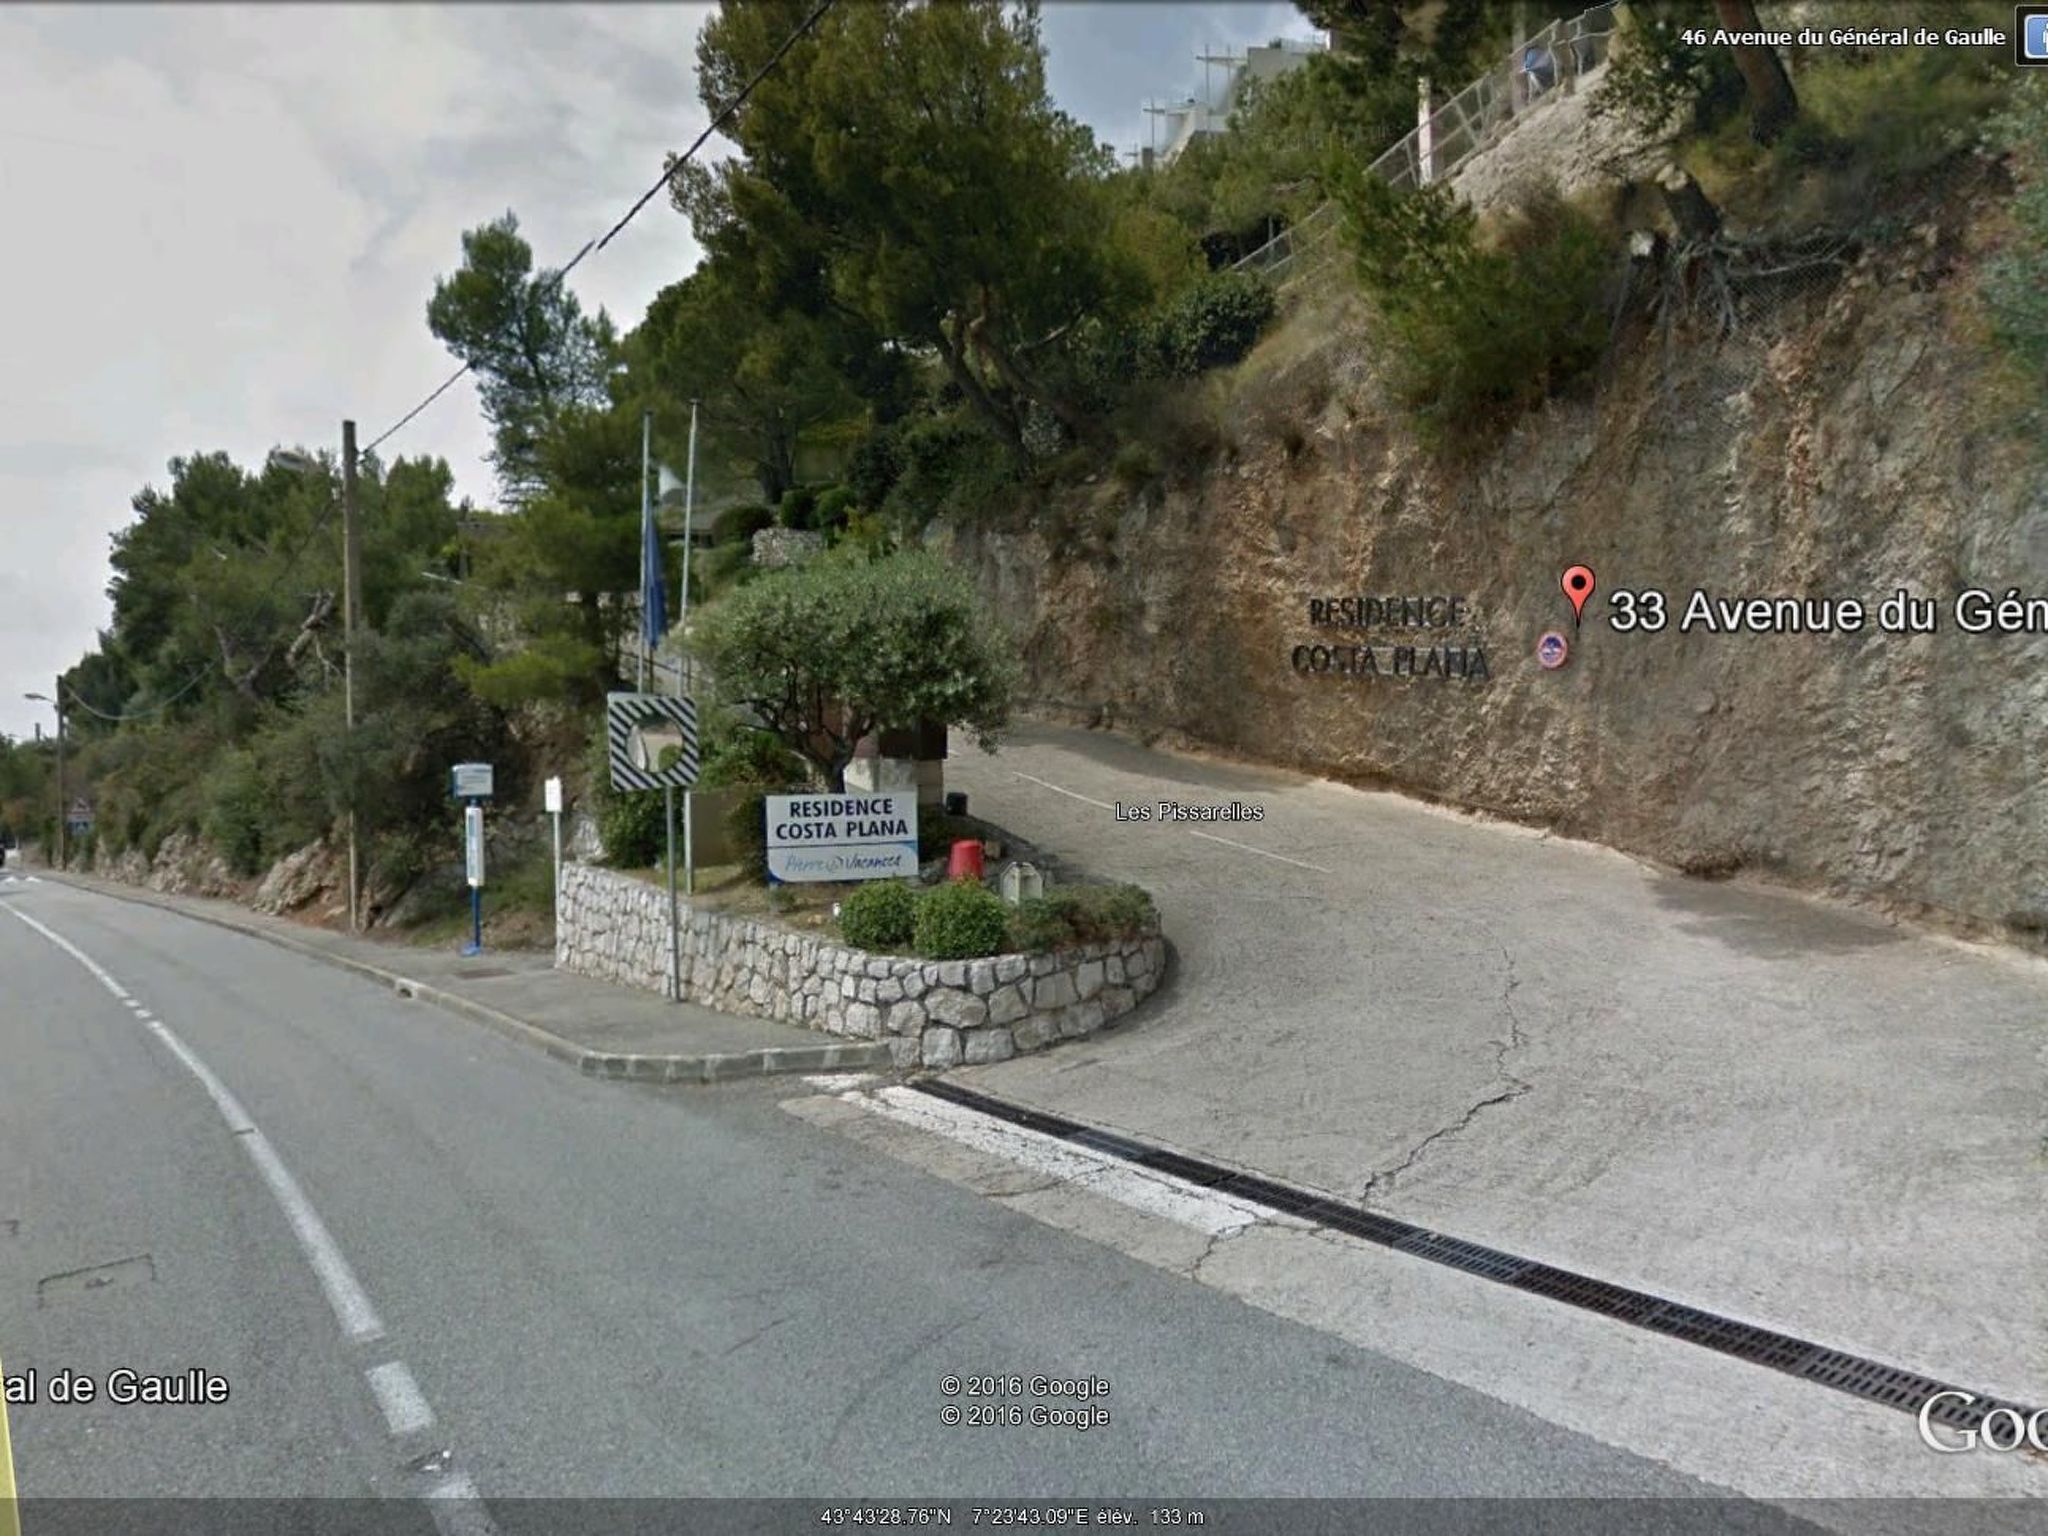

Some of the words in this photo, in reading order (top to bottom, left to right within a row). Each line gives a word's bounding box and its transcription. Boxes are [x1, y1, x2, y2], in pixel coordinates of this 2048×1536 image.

[1310, 597, 1467, 627] RESIDENCE
[1291, 644, 1379, 676] COSTA
[1393, 646, 1490, 680] PLANA
[790, 799, 893, 817] RESIDENCE
[776, 822, 837, 839] COSTA
[847, 820, 908, 837] PLANA
